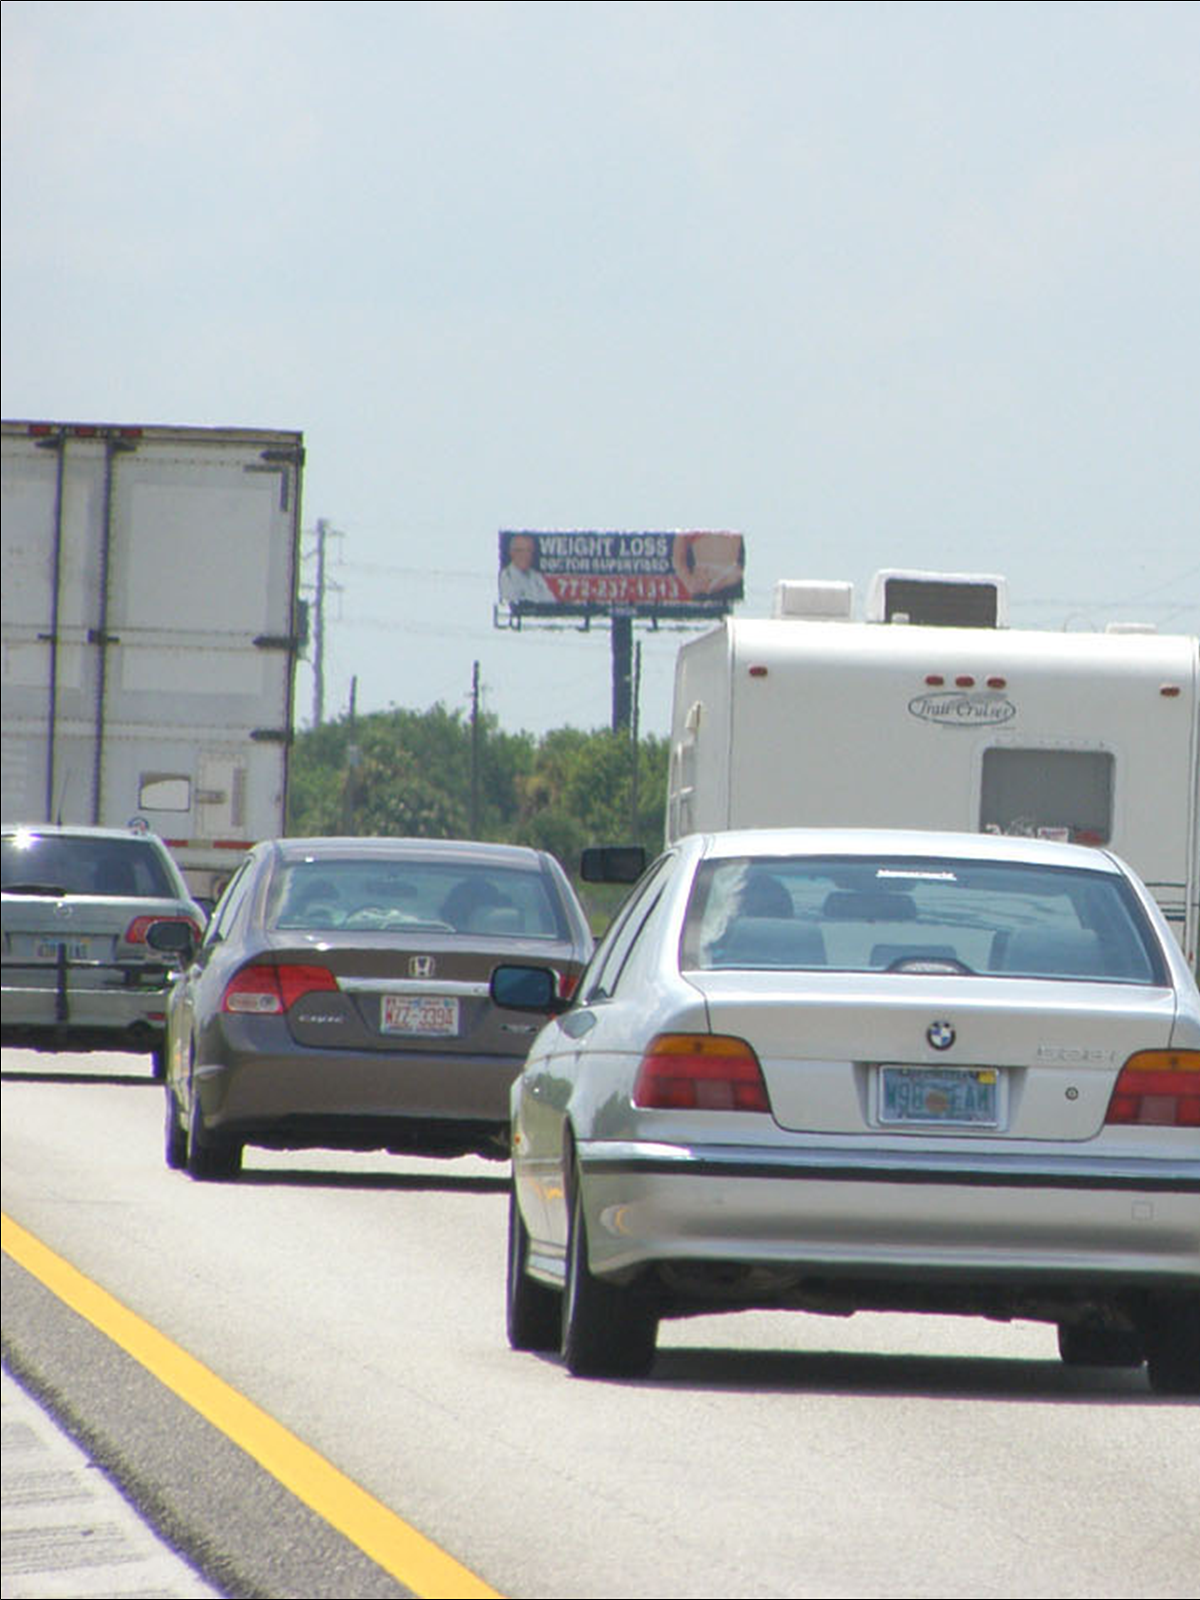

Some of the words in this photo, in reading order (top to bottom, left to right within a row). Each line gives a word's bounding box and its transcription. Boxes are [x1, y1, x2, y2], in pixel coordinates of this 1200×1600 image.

[539, 536, 614, 556] WEIGHT
[619, 536, 668, 557] LOSS
[540, 557, 590, 571] DOCTOR
[918, 699, 951, 716] Trail
[956, 700, 1010, 718] Cruiser
